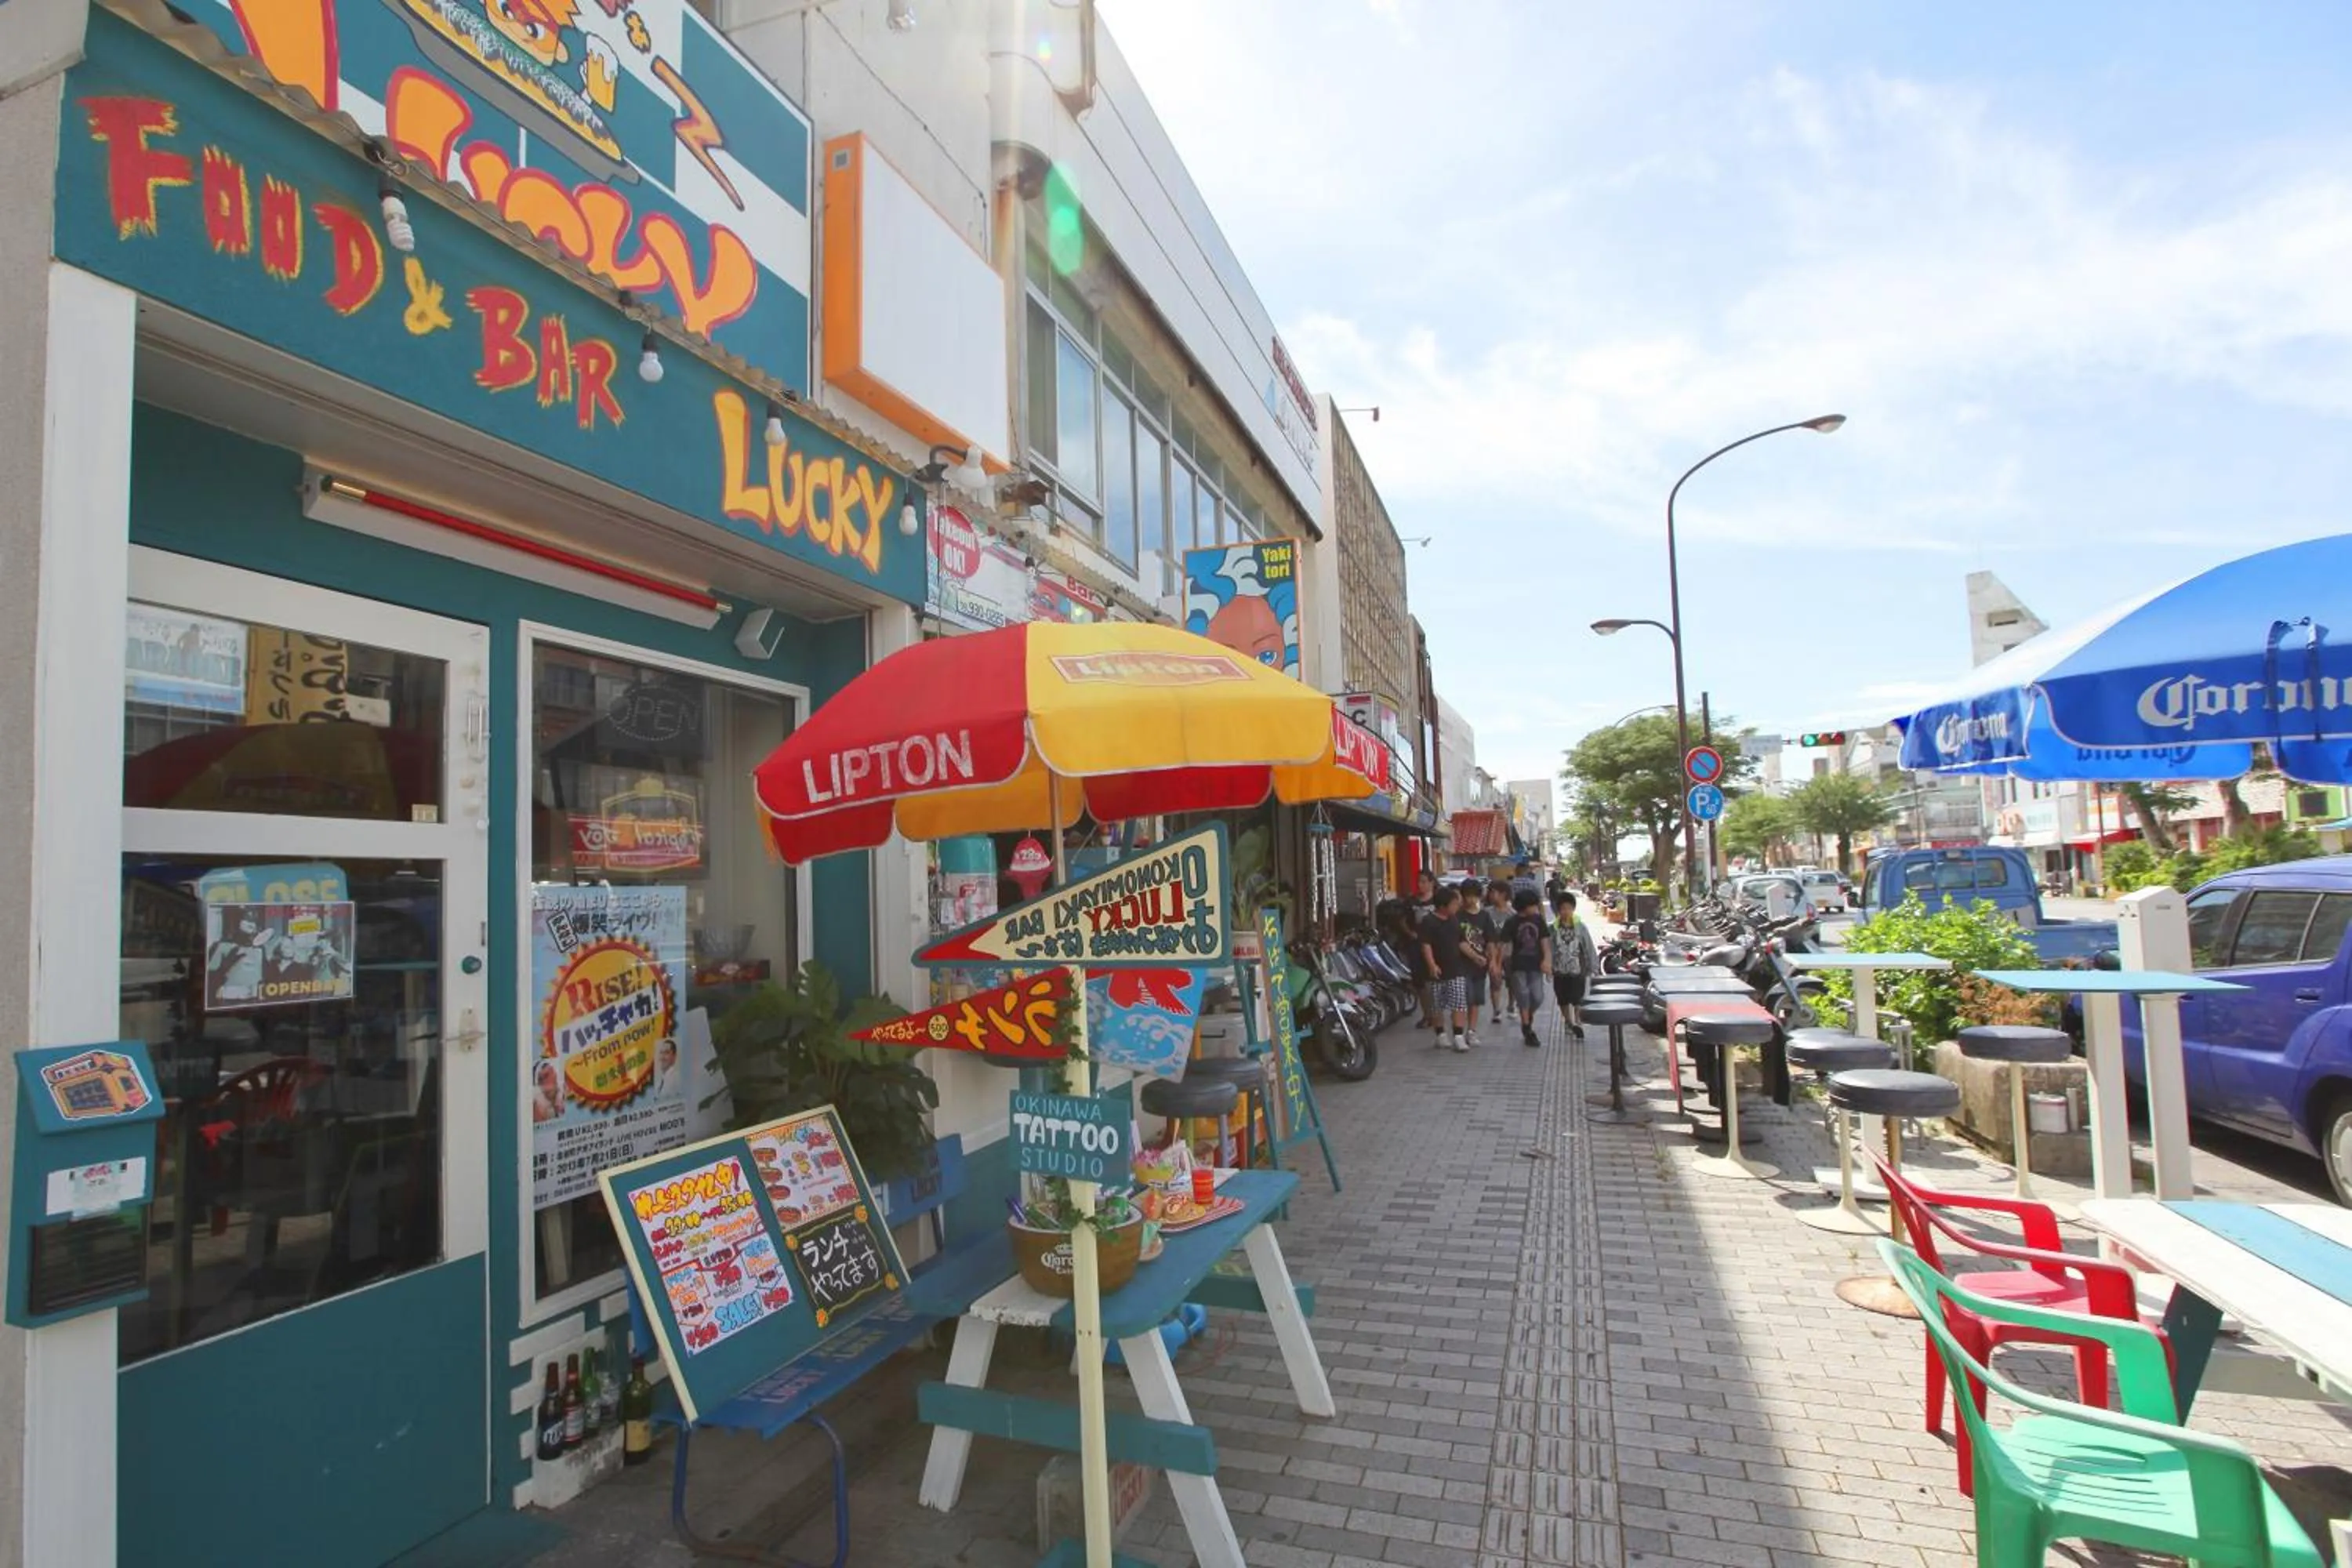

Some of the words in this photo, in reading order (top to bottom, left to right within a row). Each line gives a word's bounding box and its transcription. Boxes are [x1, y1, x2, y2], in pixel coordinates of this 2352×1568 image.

[75, 93, 384, 316] FOOD
[403, 256, 452, 336] &
[466, 285, 625, 431] BAR
[713, 388, 893, 573] LUCKY
[1262, 546, 1291, 562] Yaki
[1265, 562, 1290, 579] tori
[803, 729, 974, 804] LIPTON
[1695, 793, 1710, 815] P
[1015, 1095, 1102, 1121] OKINAWA
[1013, 1112, 1119, 1155] TATTOO
[1021, 1147, 1103, 1177] STUDIO
[803, 1226, 849, 1268] ランチ
[1041, 1252, 1073, 1267] Coro
[811, 1247, 881, 1301] やってます
[715, 1290, 764, 1333] SALE!
